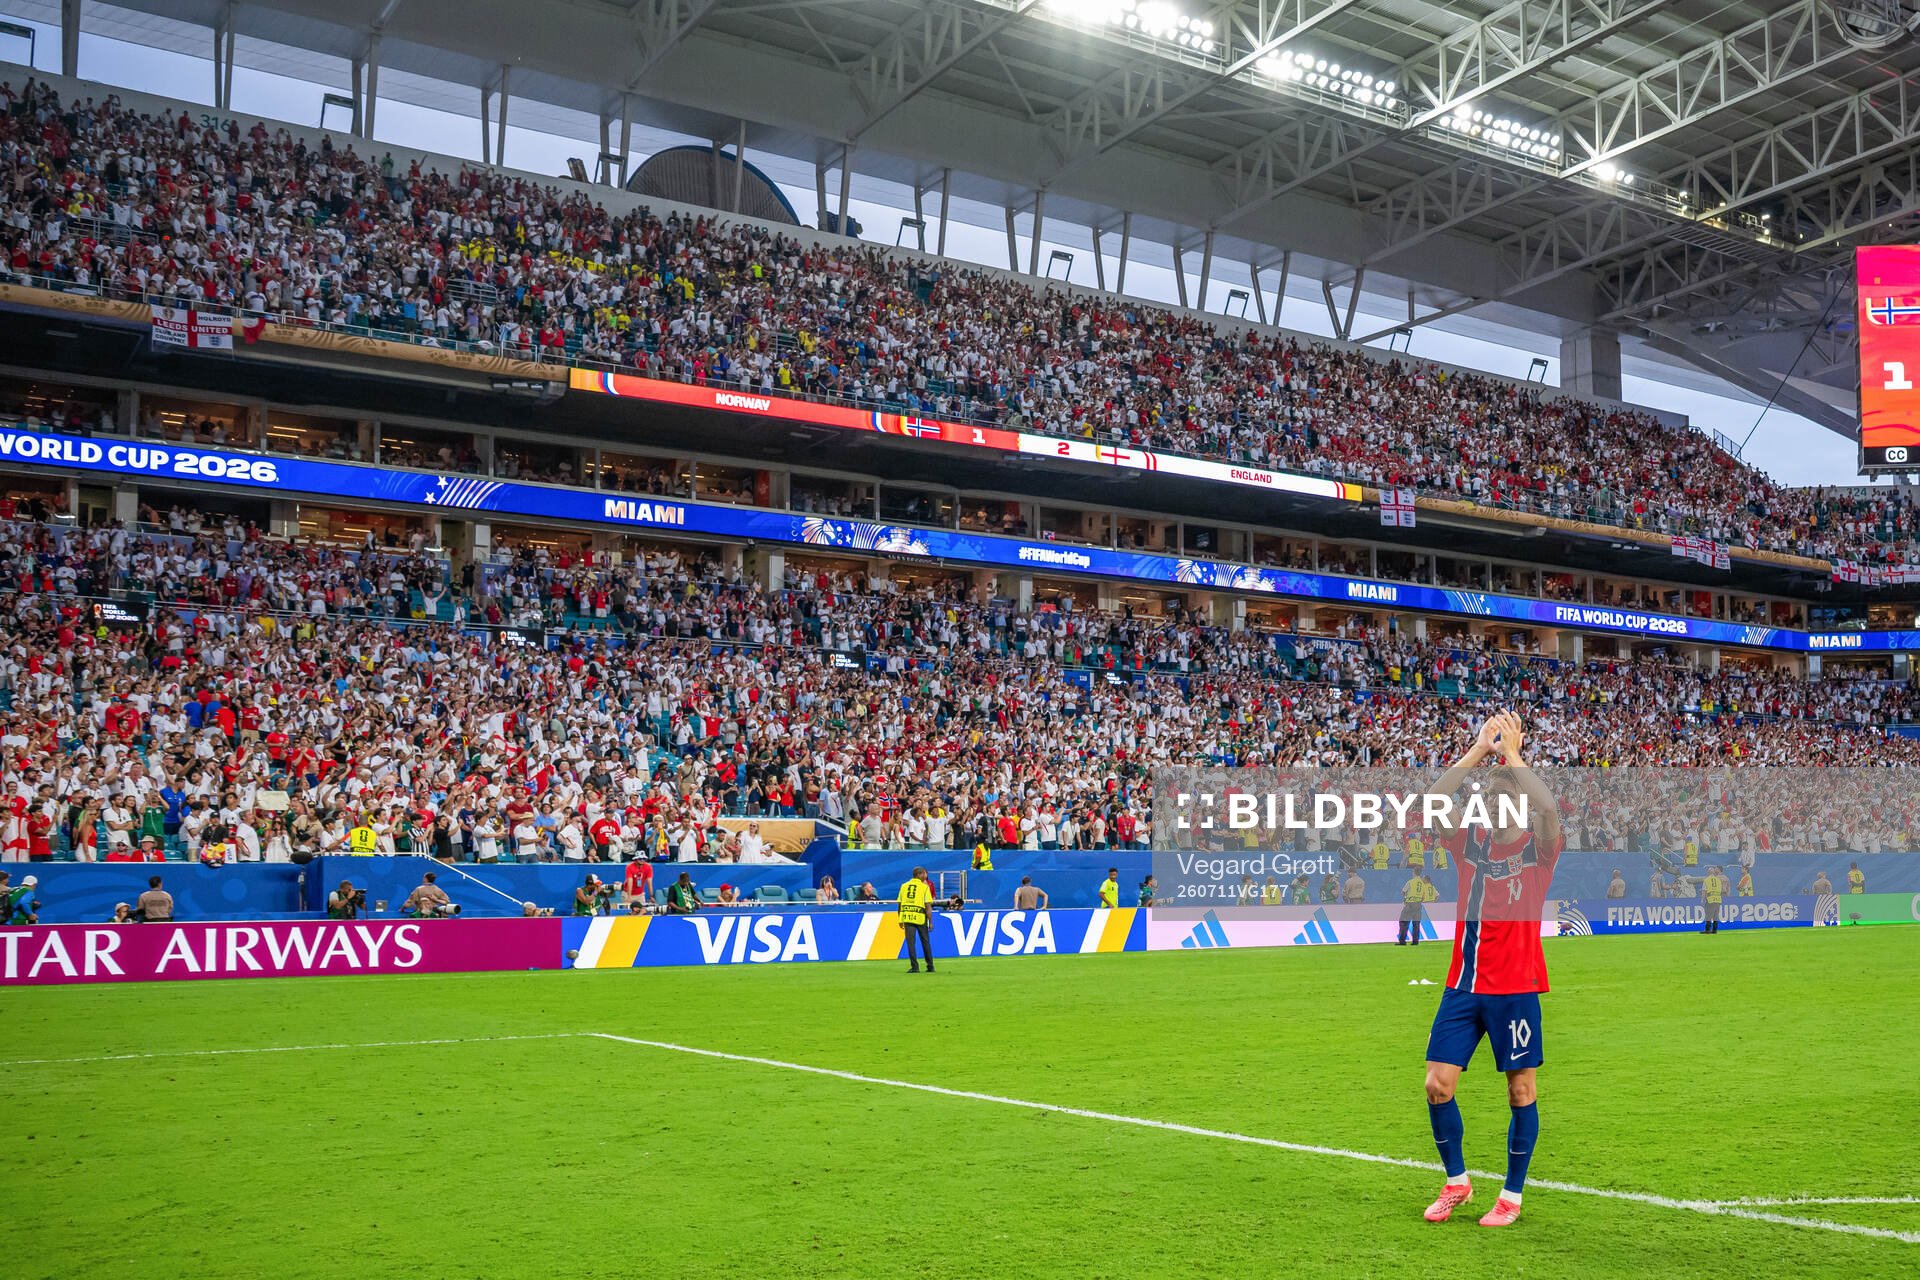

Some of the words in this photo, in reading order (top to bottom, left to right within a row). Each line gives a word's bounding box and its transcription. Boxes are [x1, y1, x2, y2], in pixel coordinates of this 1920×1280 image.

[157, 319, 188, 332] LEEDS
[191, 325, 228, 334] UNITED
[1883, 361, 1913, 390] 1
[716, 392, 770, 411] NORWAY
[972, 428, 986, 444] 1
[1057, 441, 1070, 456] 2
[1231, 469, 1272, 484] ENGLAND
[108, 445, 169, 470] CUP
[174, 453, 278, 482] 2026
[1887, 450, 1905, 460] CC
[605, 499, 685, 525] MIAMI
[1018, 546, 1091, 569] #FIFAWorldCup
[1348, 582, 1397, 602] MIAMI
[1556, 606, 1582, 622] FIFA
[1582, 609, 1624, 627] WORLD
[1625, 614, 1648, 630] CUP
[1649, 617, 1688, 634] 2026
[1809, 635, 1861, 648] MIAMI
[1607, 906, 1642, 927] FIFA
[1647, 904, 1706, 925] WORLD
[1741, 902, 1794, 922] 2026
[683, 914, 820, 964] VISA
[941, 910, 1057, 956] VISA
[155, 924, 422, 973] AIRWAYS
[1508, 1018, 1532, 1049] 10
